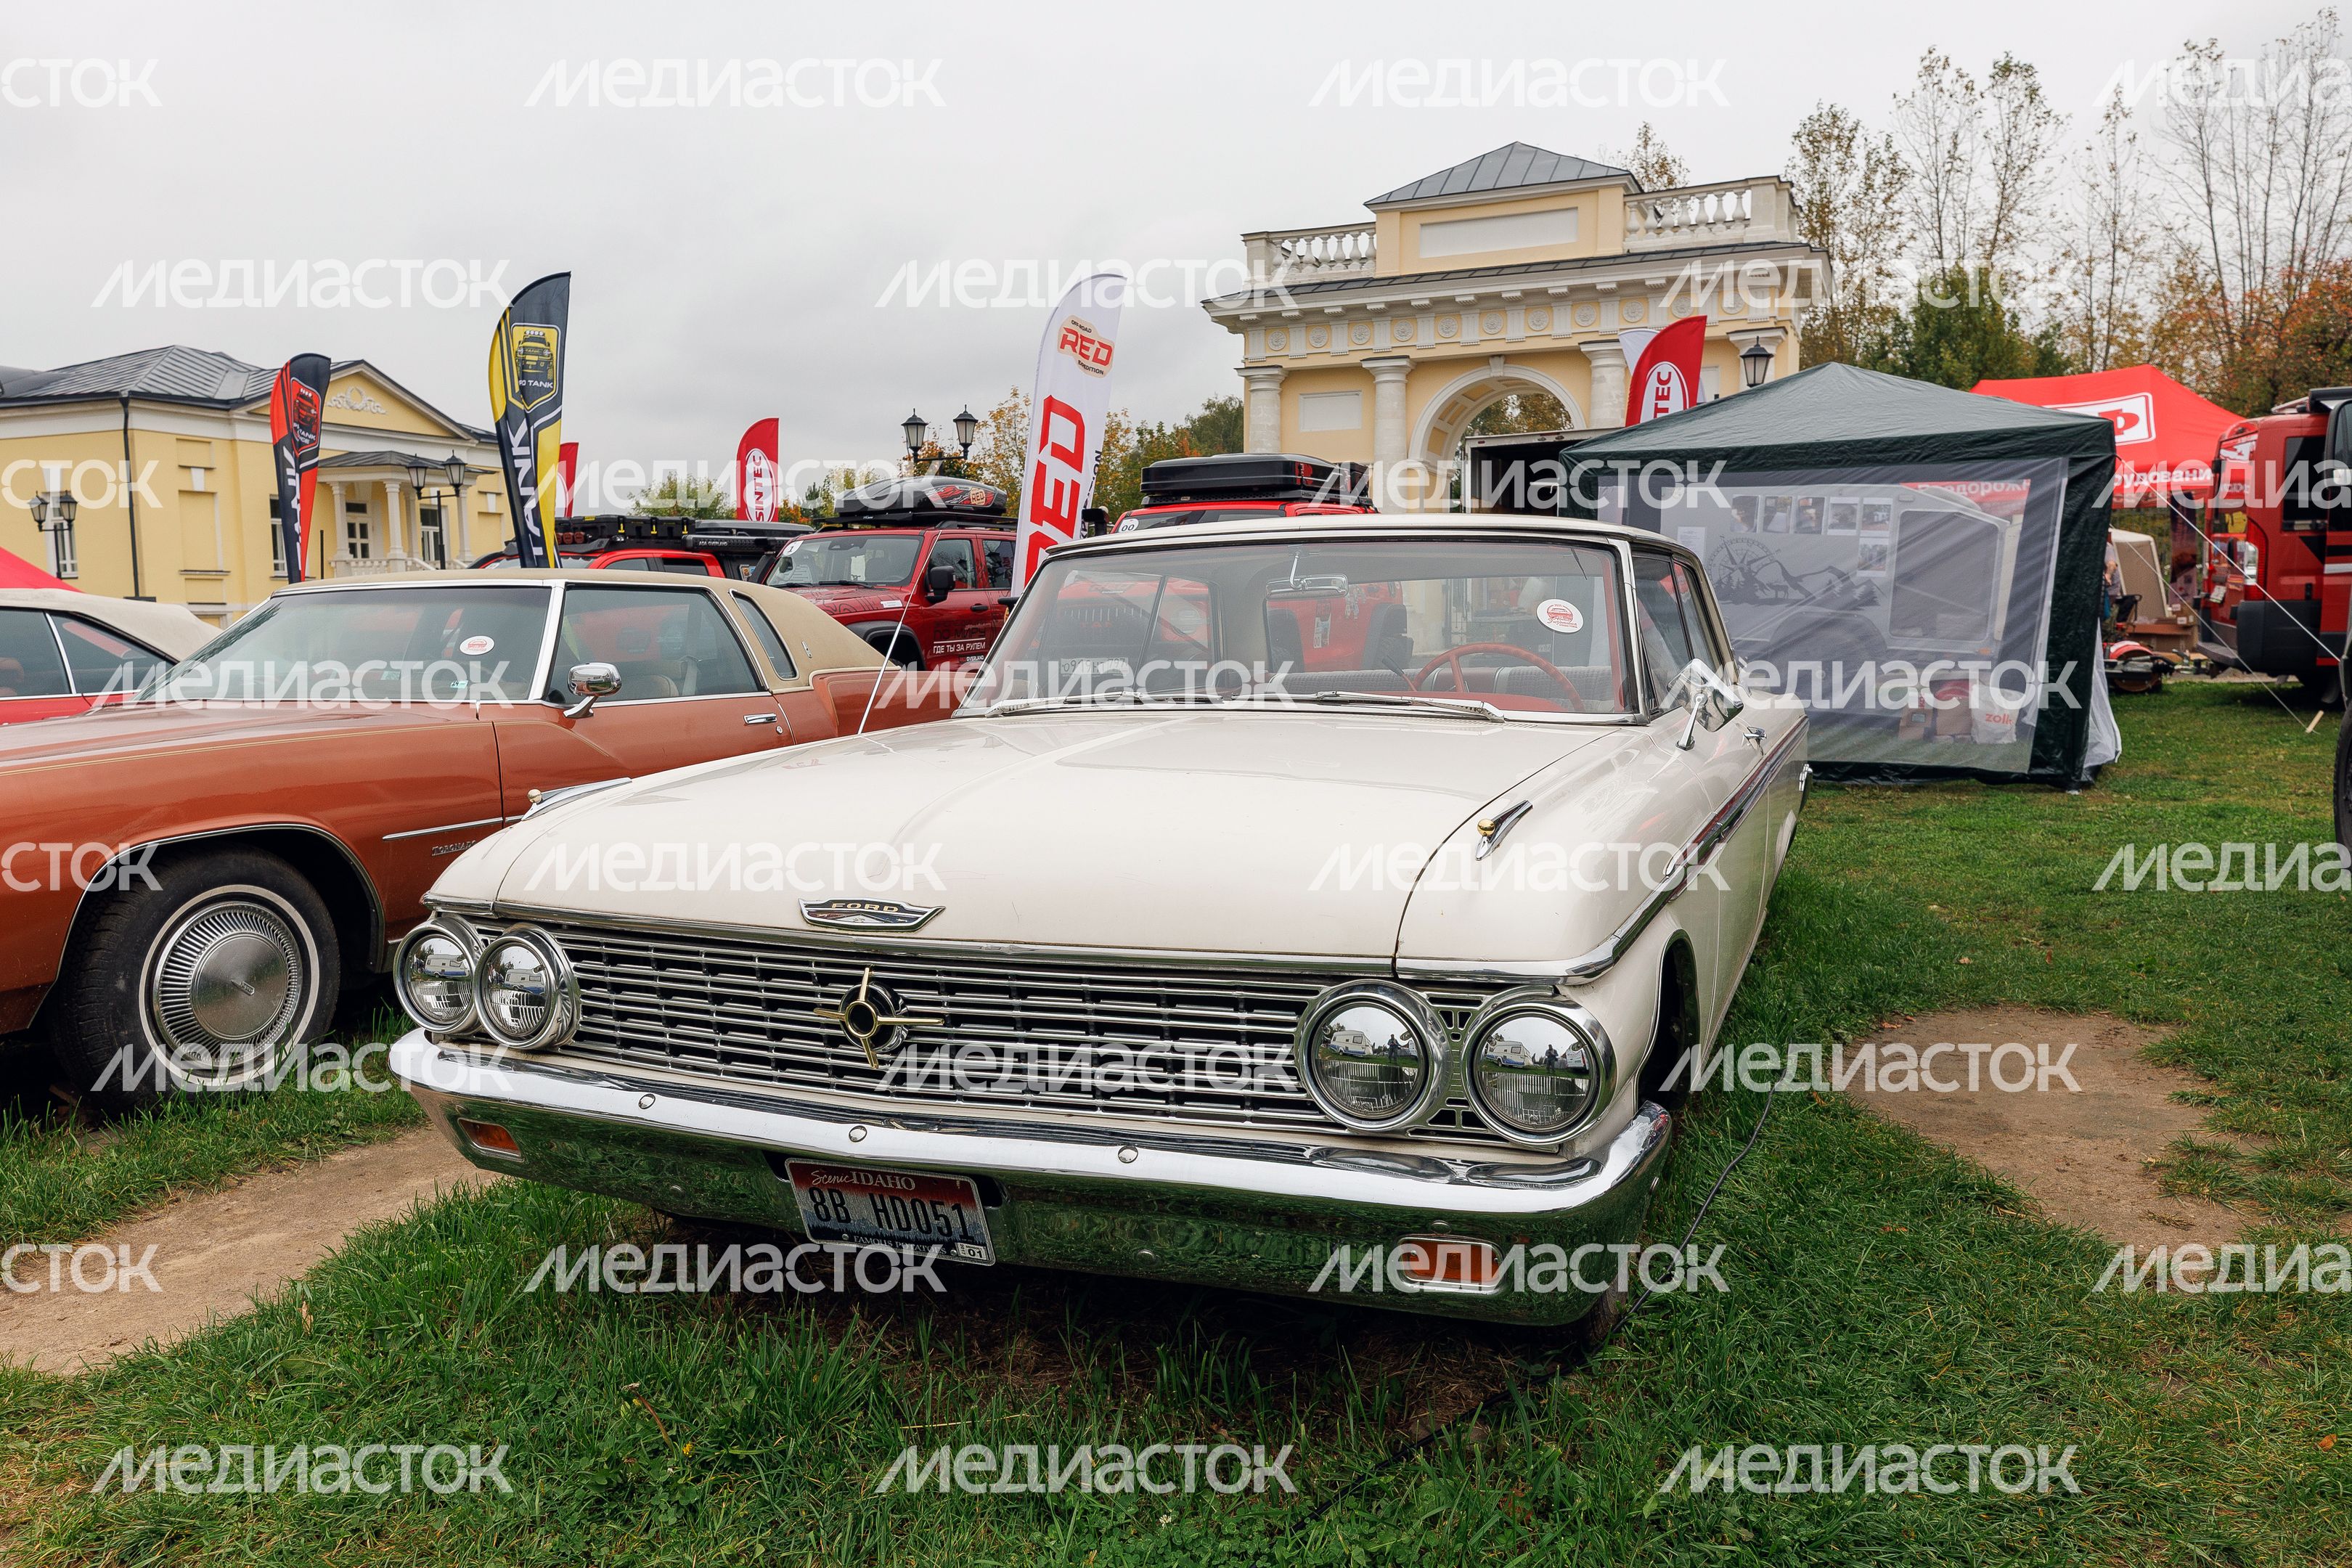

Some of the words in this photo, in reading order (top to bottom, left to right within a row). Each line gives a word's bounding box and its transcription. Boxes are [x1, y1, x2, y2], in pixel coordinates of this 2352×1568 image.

[1060, 327, 1113, 366] RED
[528, 380, 553, 388] TANK
[1654, 371, 1672, 418] TEC
[2114, 468, 2212, 488] рудовани
[506, 417, 544, 566] TANK
[753, 455, 764, 522] SINTEC
[972, 491, 984, 502] RED
[956, 643, 965, 652] ЗА
[965, 642, 986, 650] РУЛЕМ
[831, 903, 899, 912] FORD
[811, 1170, 854, 1185] Scenic
[851, 1171, 916, 1191] IDAHO
[808, 1187, 852, 1224] 8B
[854, 1236, 893, 1247] FAMOUS
[895, 1241, 947, 1255] POTATOES
[968, 1249, 983, 1258] 01
